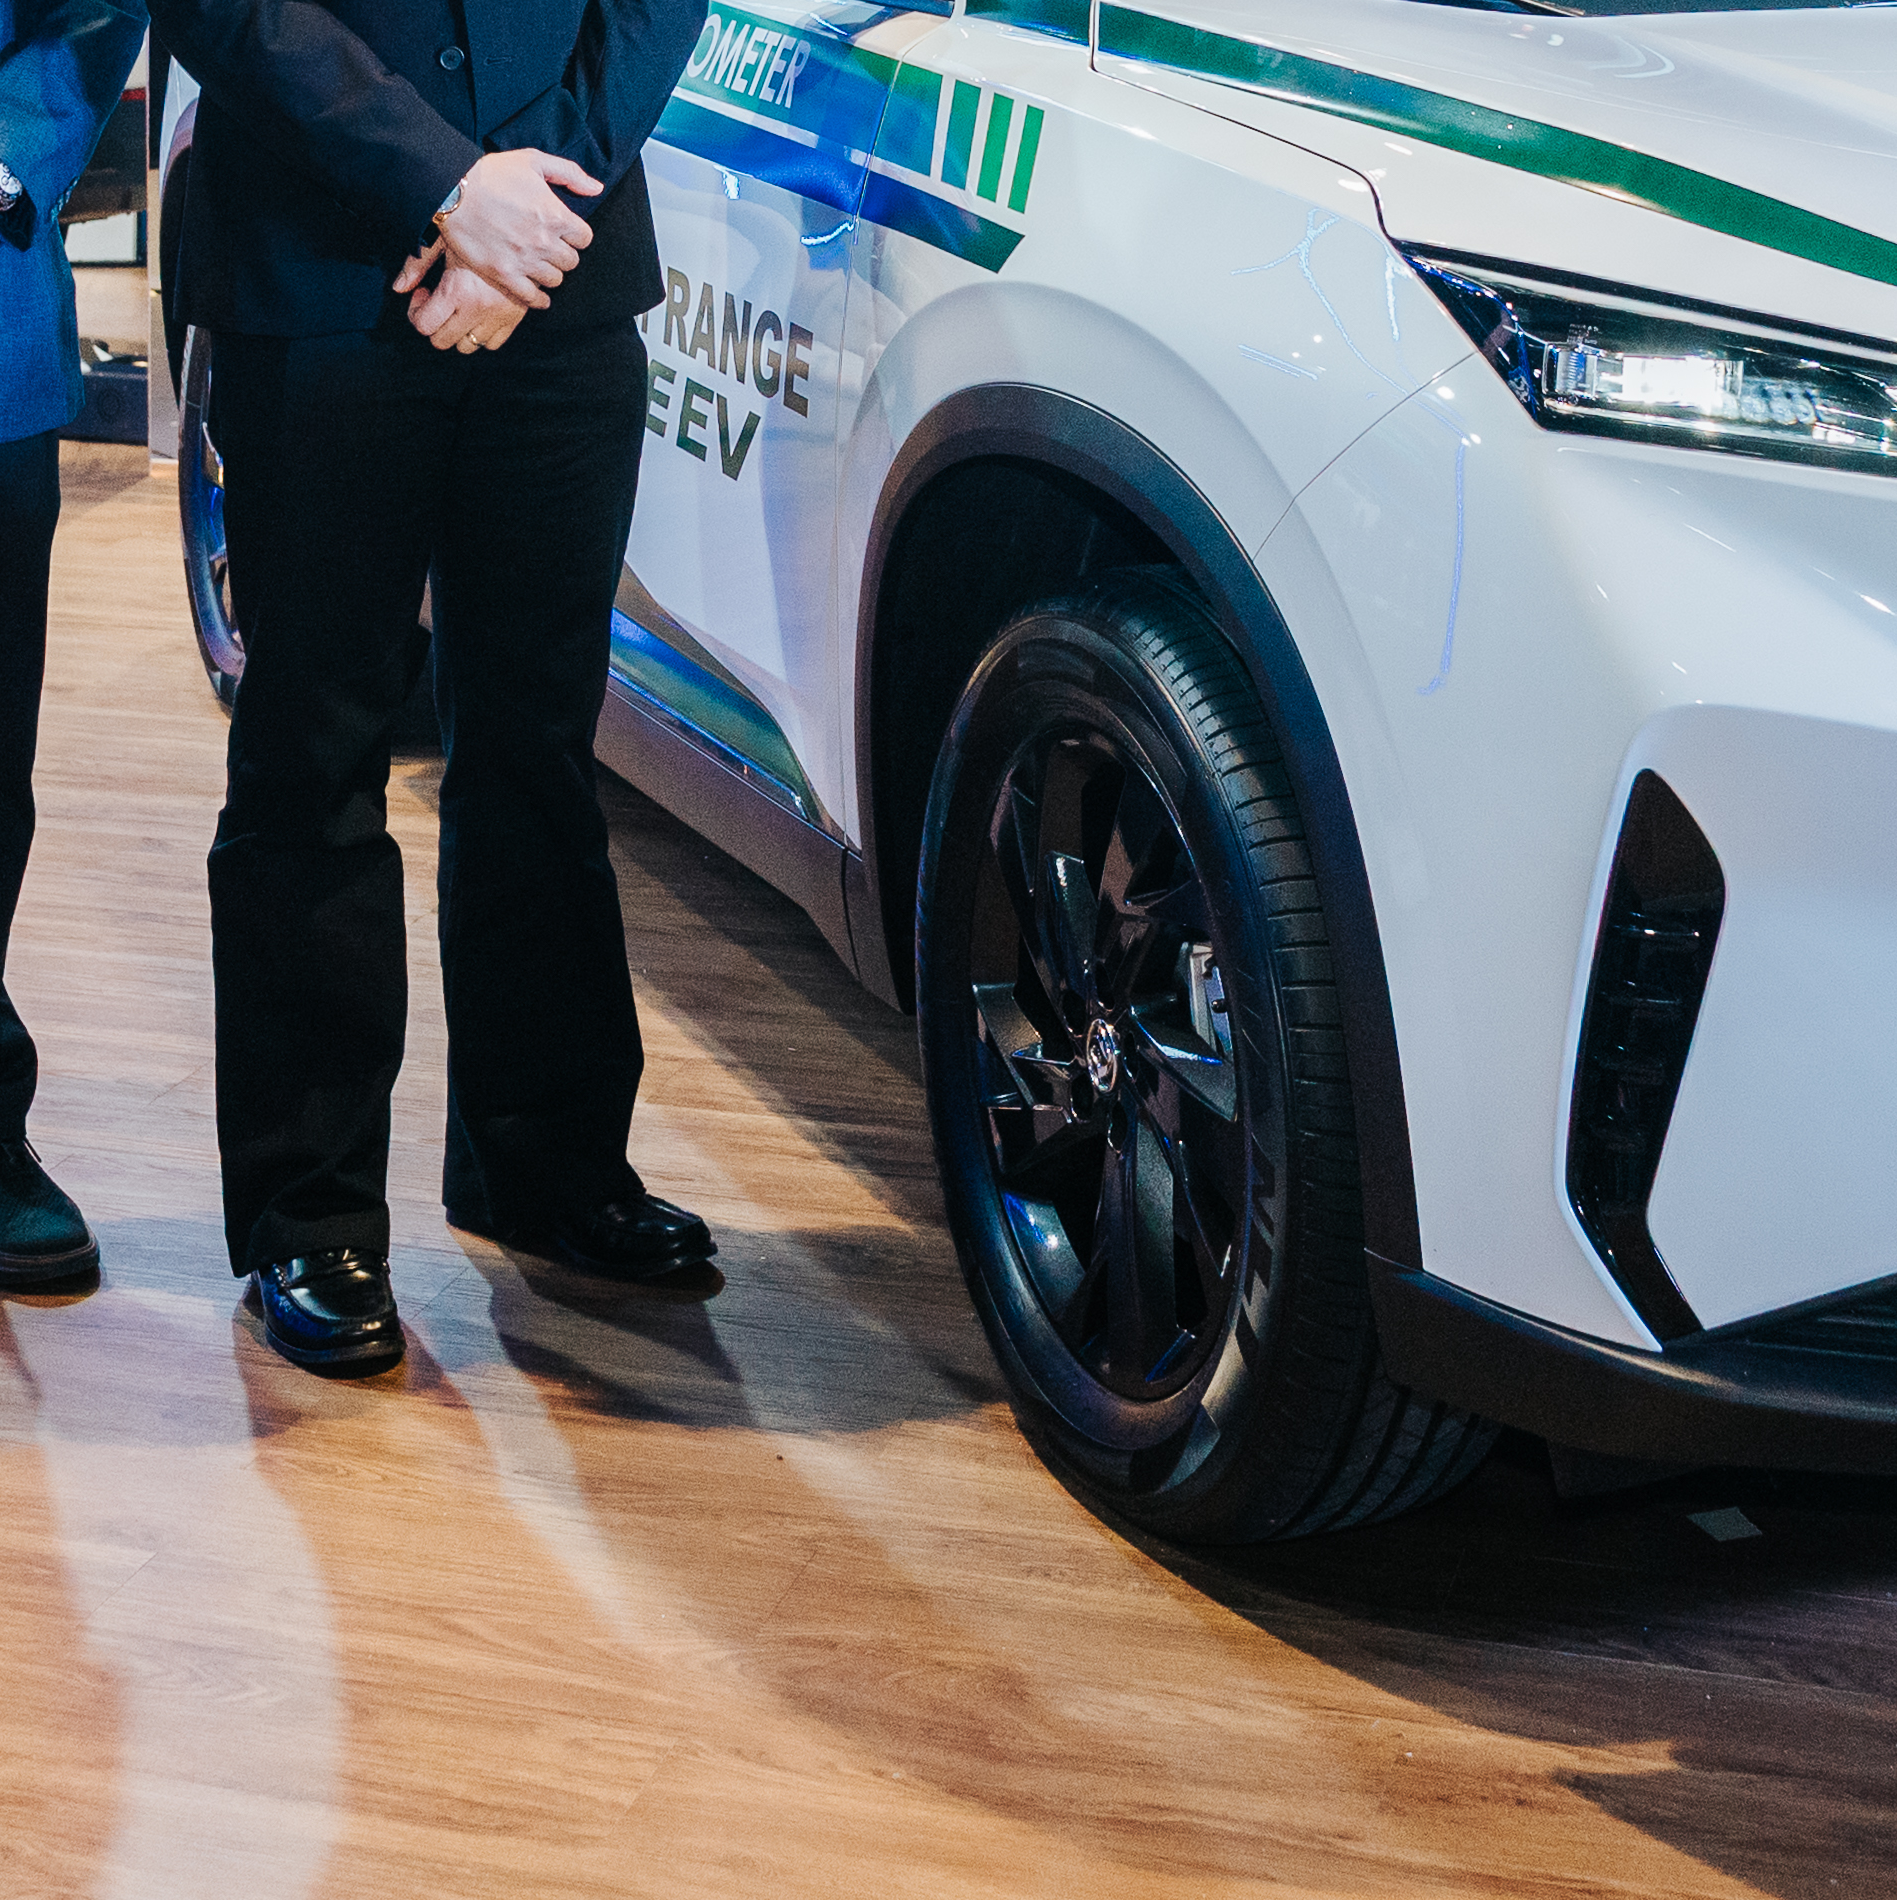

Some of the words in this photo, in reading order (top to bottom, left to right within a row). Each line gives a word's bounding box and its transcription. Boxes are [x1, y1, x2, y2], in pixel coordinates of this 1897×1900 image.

[687, 13, 811, 109] OMETER
[663, 266, 813, 418] RANGE
[676, 377, 761, 481] EV
